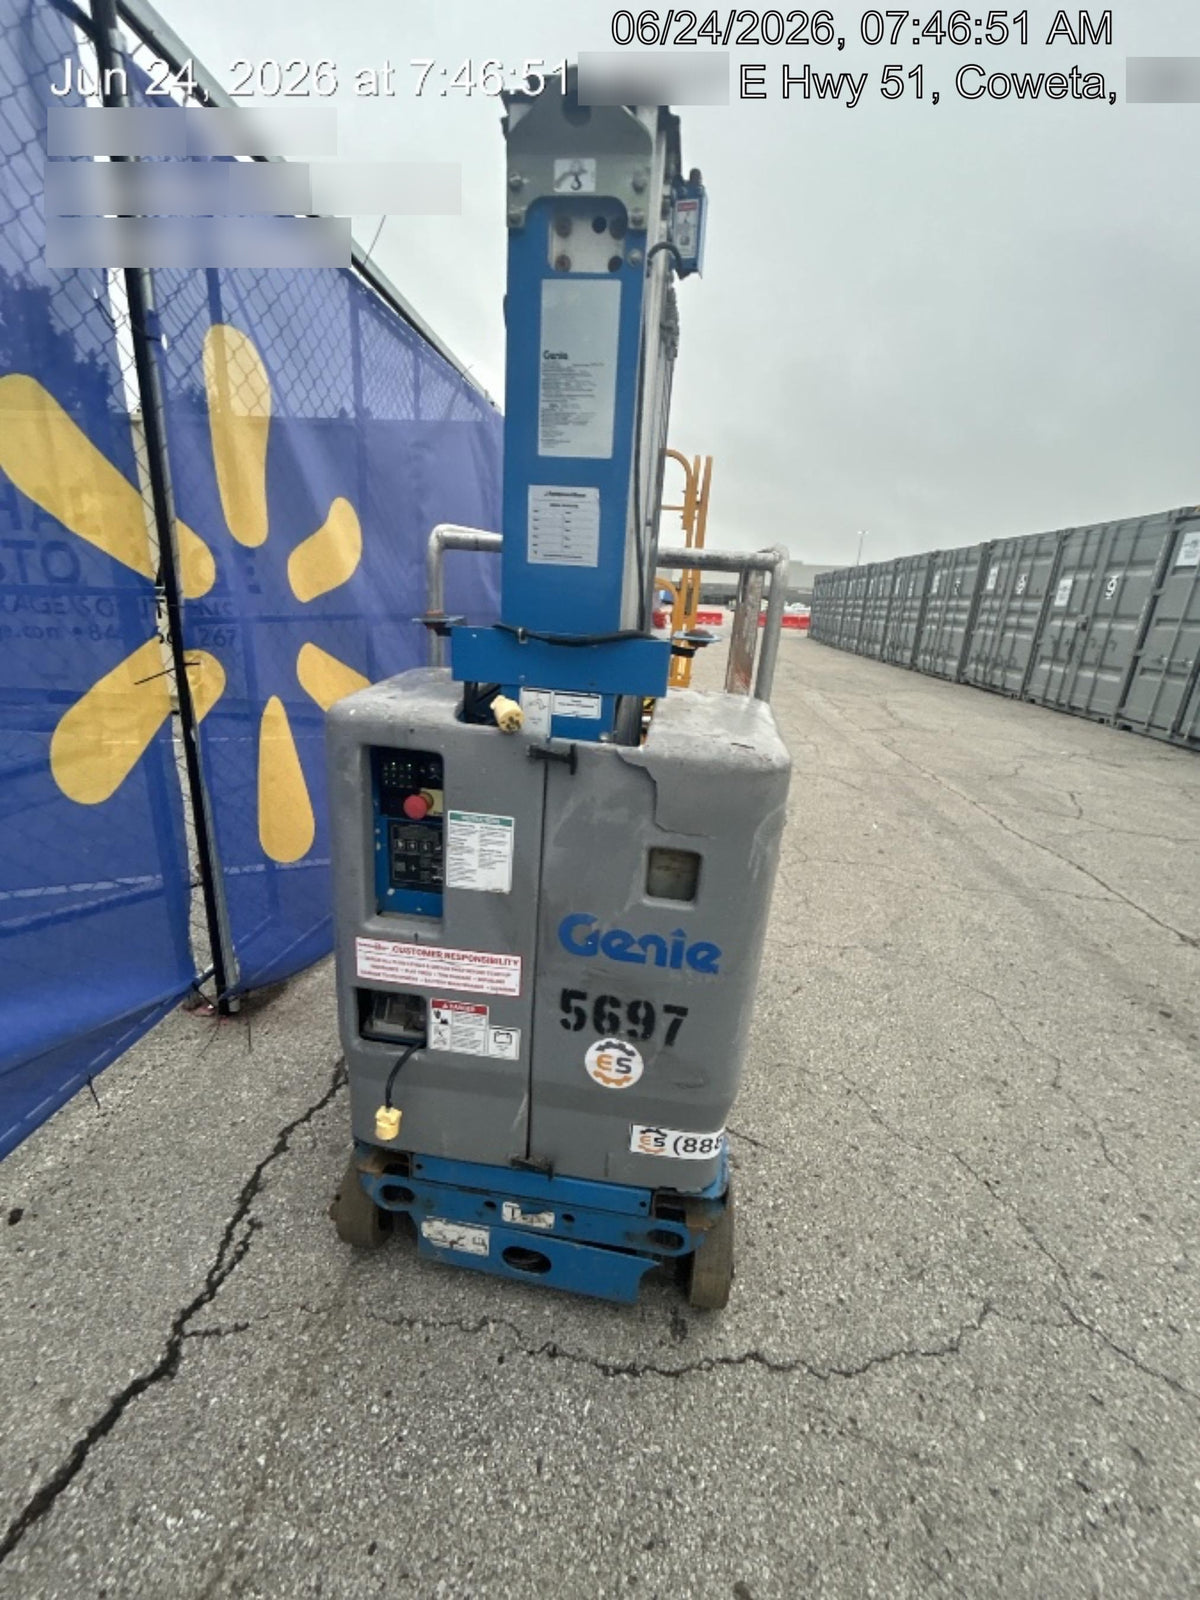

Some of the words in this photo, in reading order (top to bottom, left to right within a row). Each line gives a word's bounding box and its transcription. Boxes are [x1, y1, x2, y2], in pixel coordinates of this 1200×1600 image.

[392, 945, 443, 959] CUSTOMER
[443, 951, 519, 967] RESPONSIBILITY
[558, 911, 722, 974] Genie
[559, 987, 689, 1047] 5697
